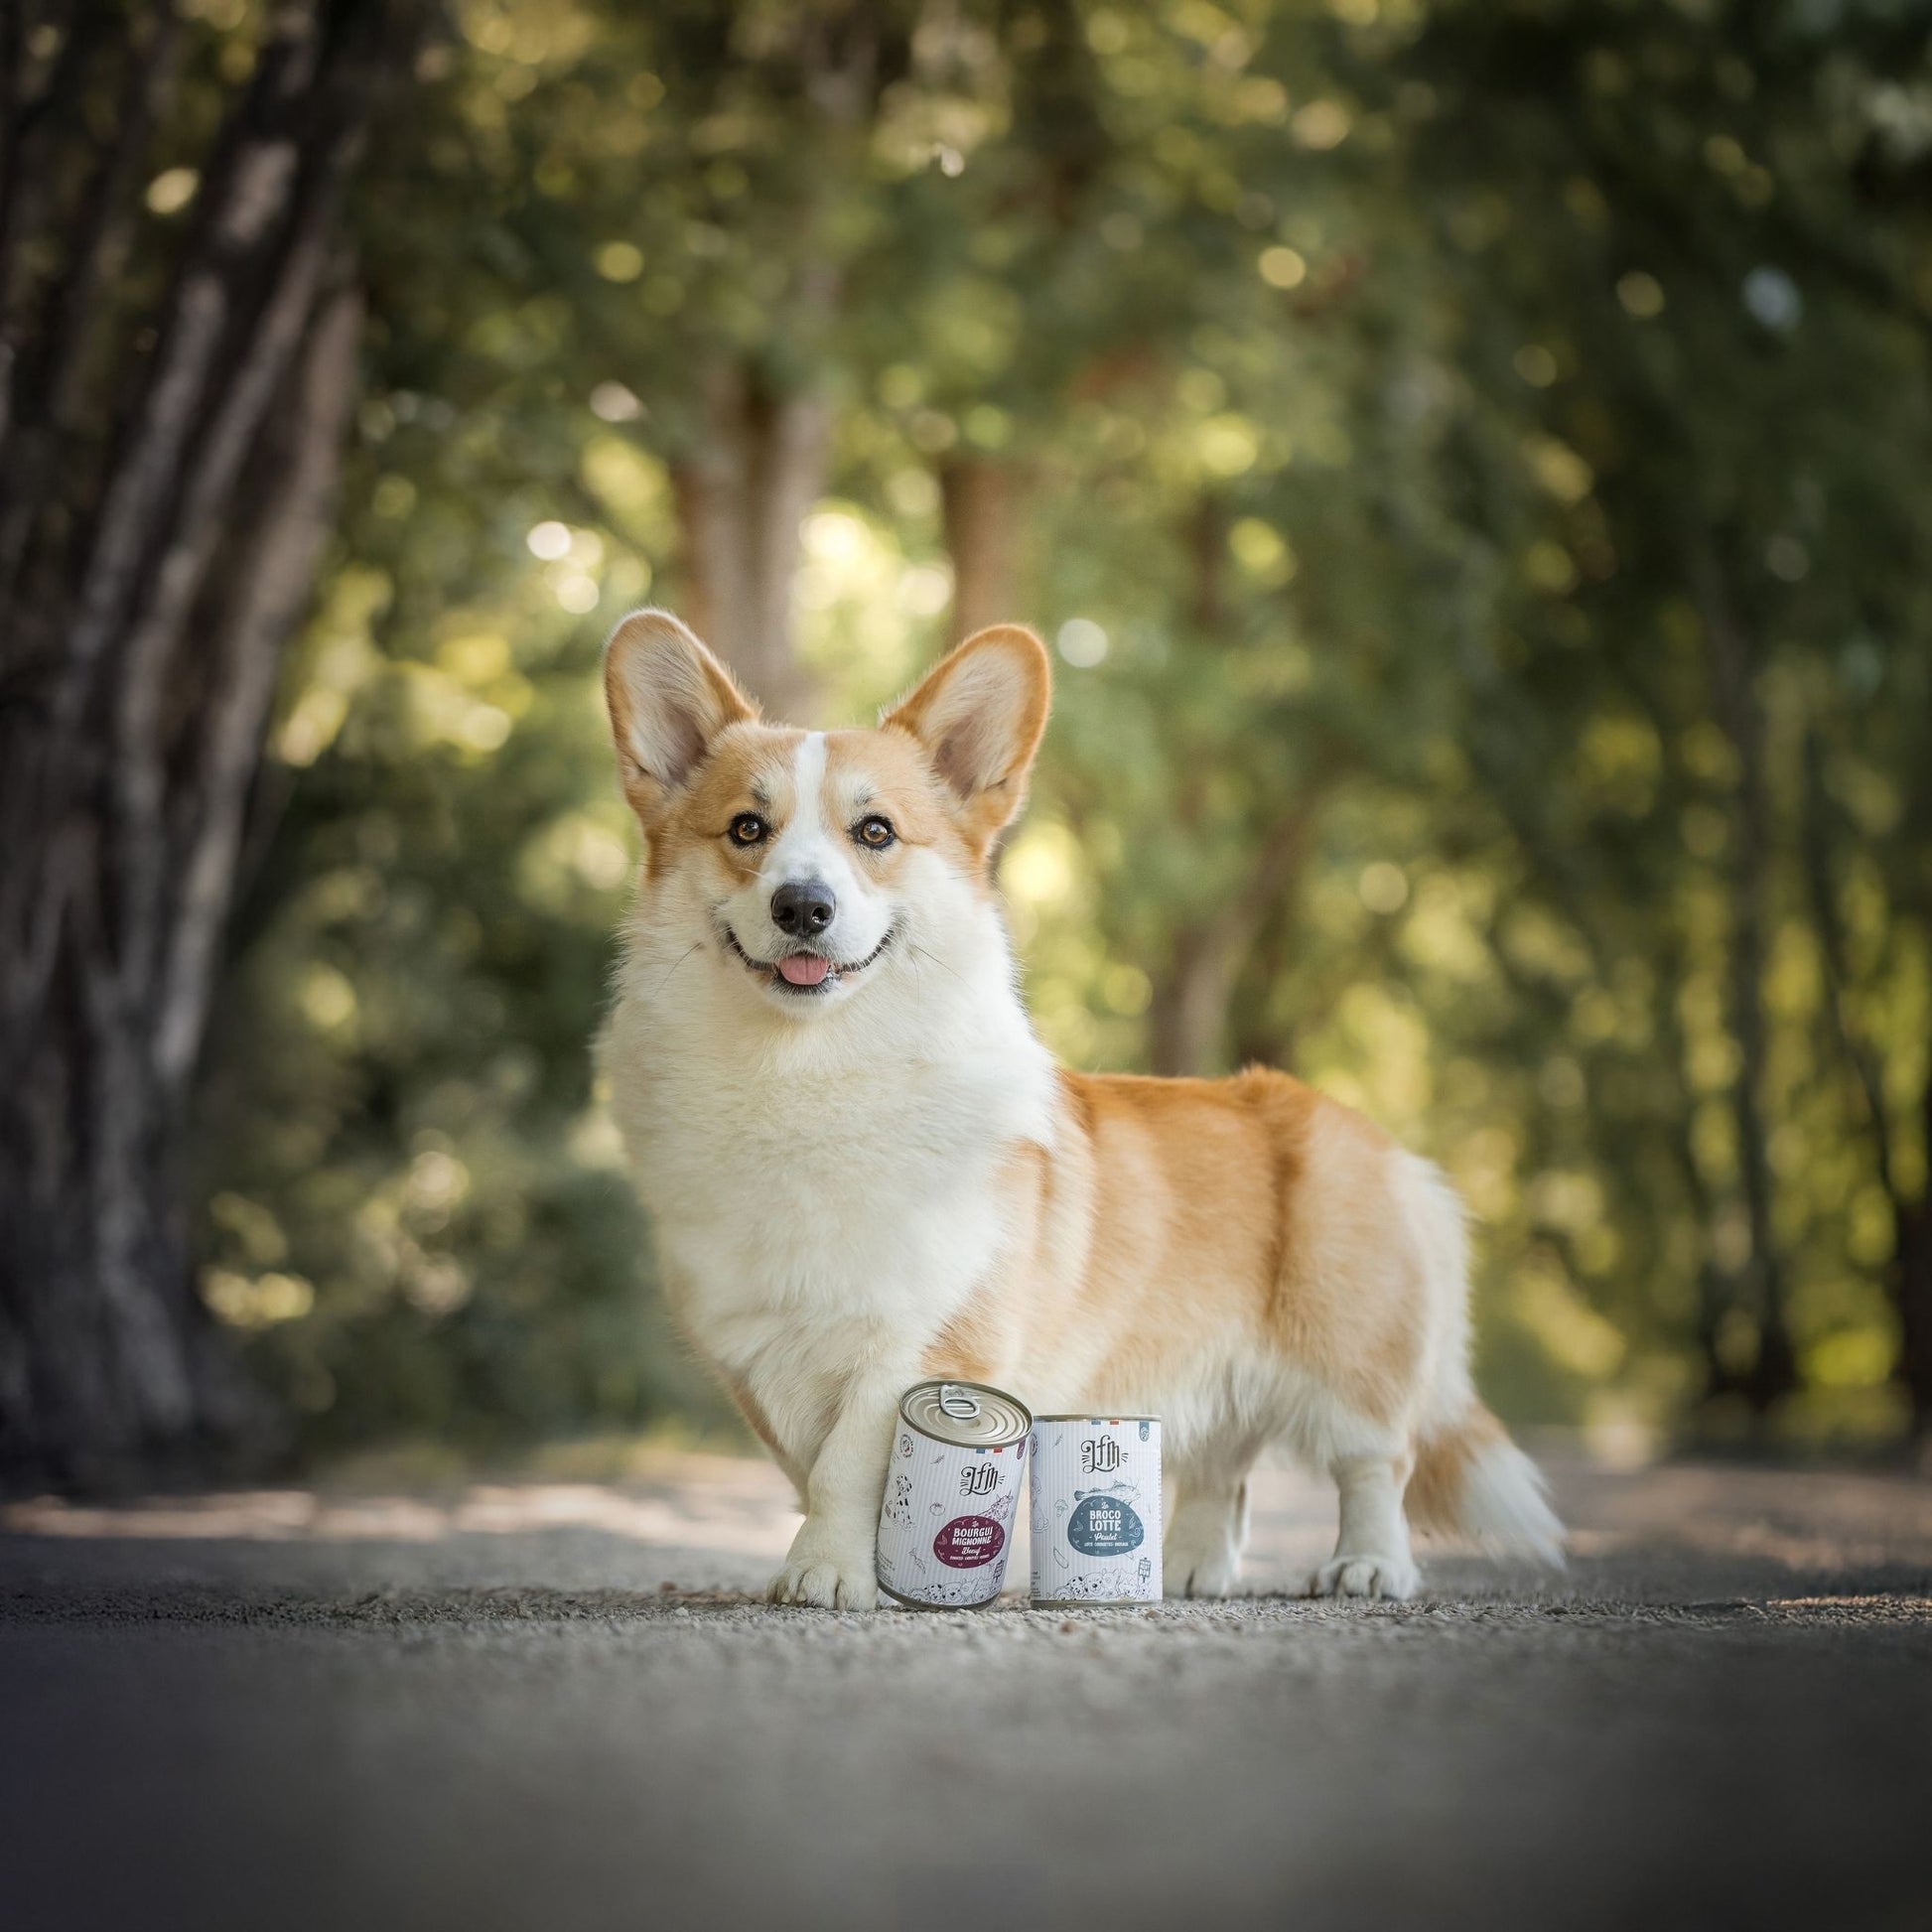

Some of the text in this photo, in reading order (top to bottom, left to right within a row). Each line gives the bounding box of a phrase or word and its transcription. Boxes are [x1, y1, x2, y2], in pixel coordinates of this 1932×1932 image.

[1089, 1510, 1121, 1520] BROCO
[1089, 1520, 1121, 1532] LOTTE
[954, 1526, 993, 1538] BOURGUI
[952, 1536, 992, 1546] MIGNONNE
